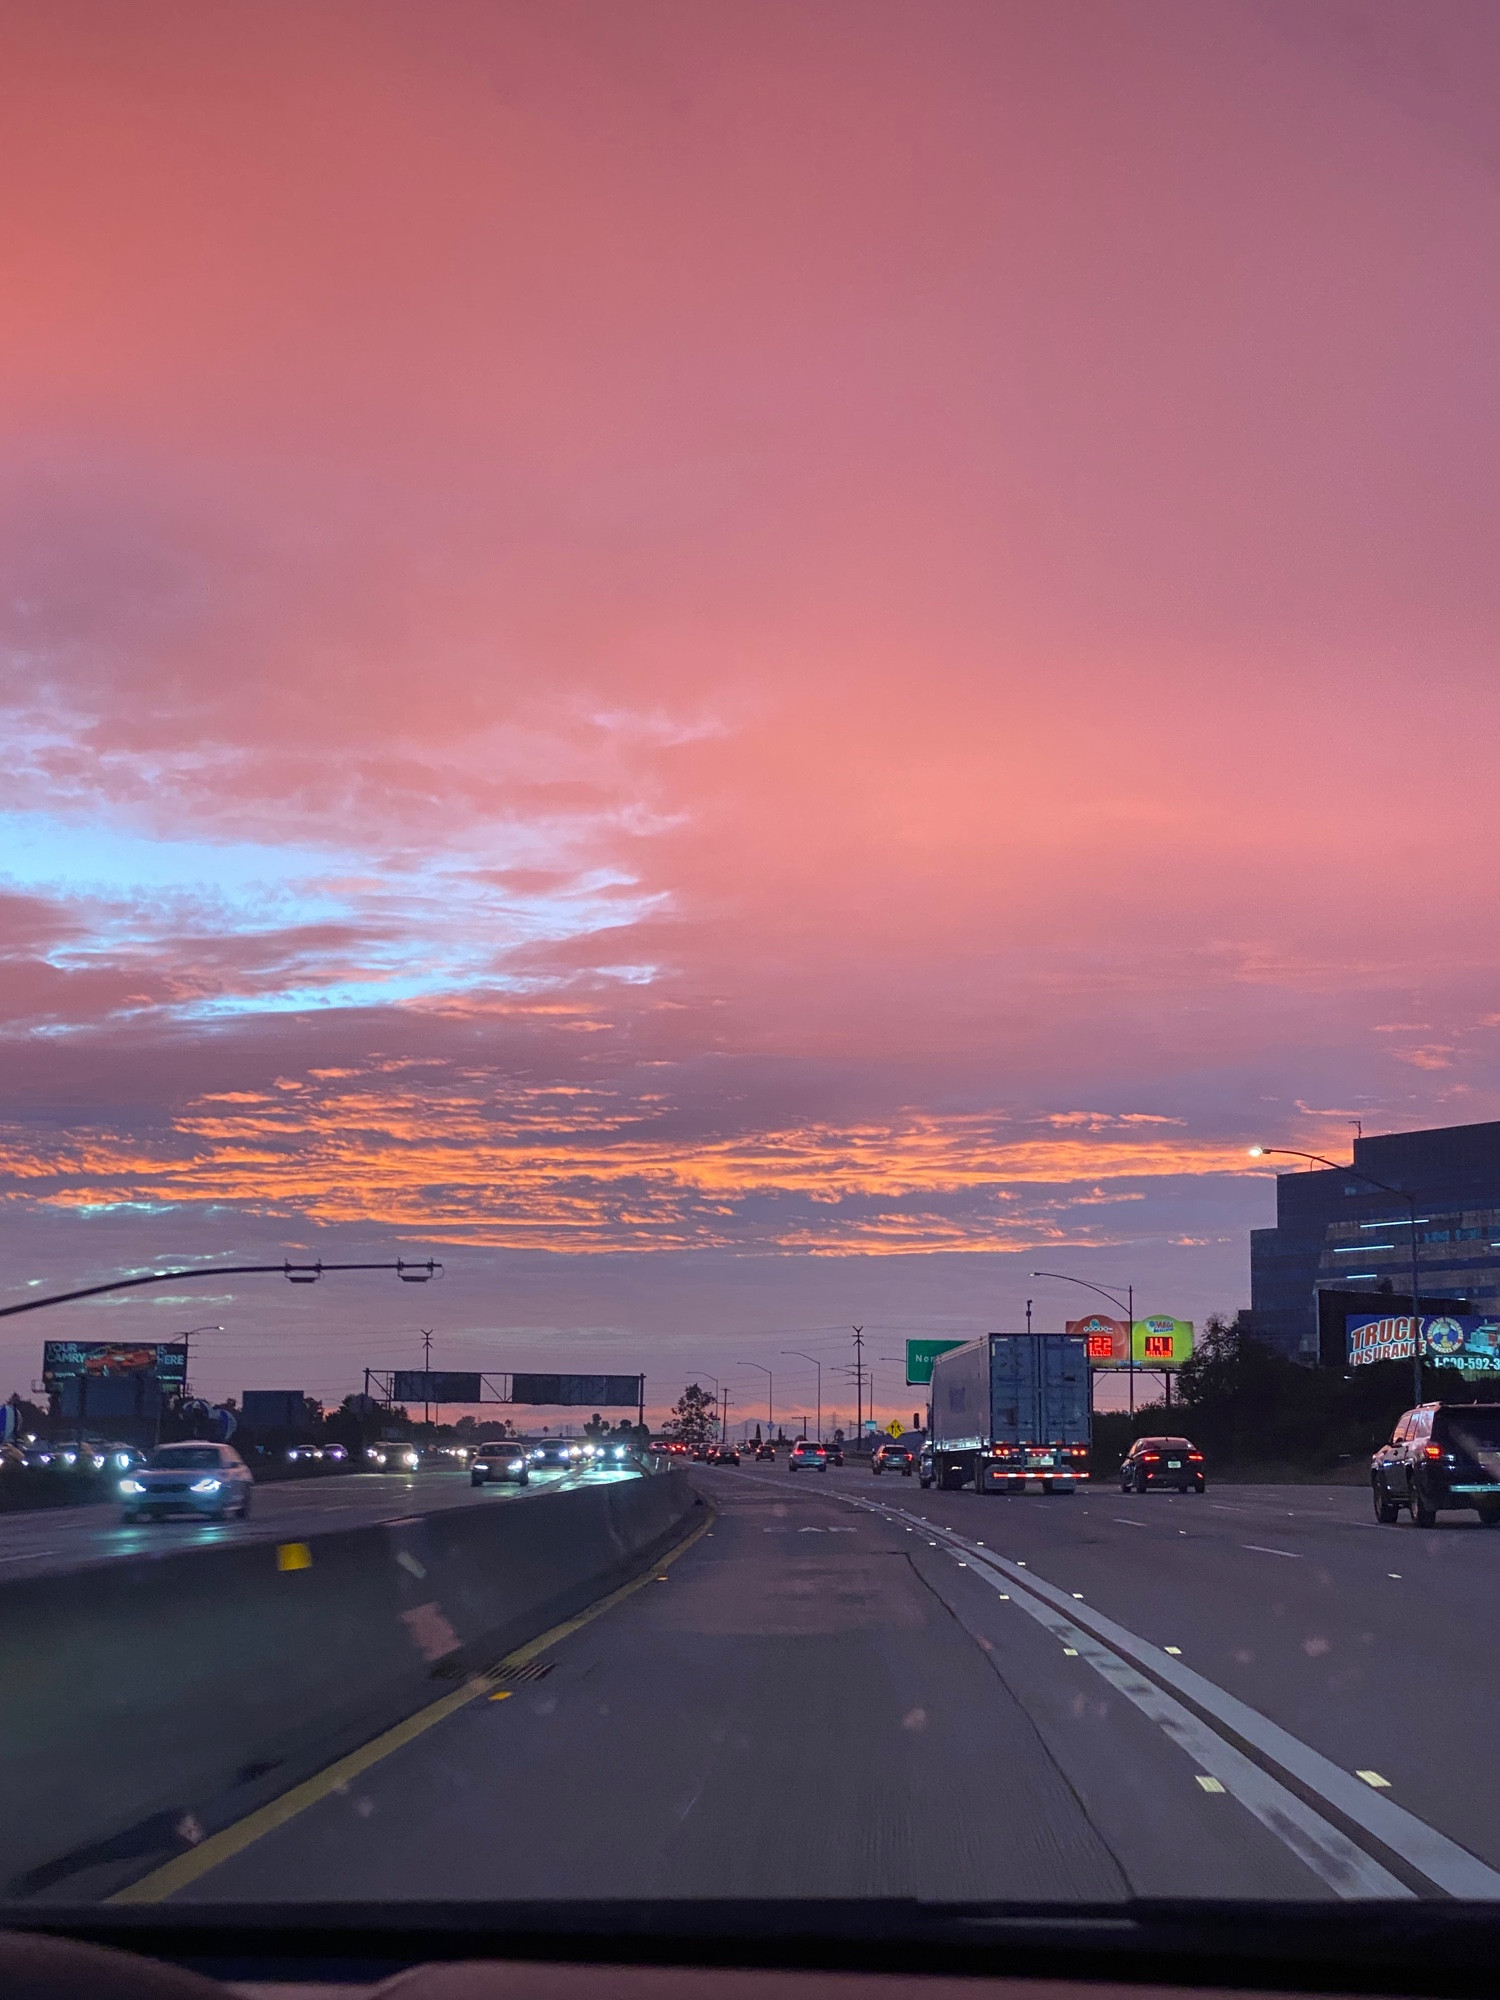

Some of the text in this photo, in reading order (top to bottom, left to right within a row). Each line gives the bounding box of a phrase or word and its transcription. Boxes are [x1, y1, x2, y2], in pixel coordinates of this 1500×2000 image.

[1351, 1317, 1425, 1351] TRUCK
[47, 1343, 77, 1353] YOUR
[1149, 1338, 1172, 1351] 141
[46, 1353, 87, 1363] CAMRY
[157, 1354, 185, 1365] HERE
[1349, 1340, 1427, 1367] INSURANCE
